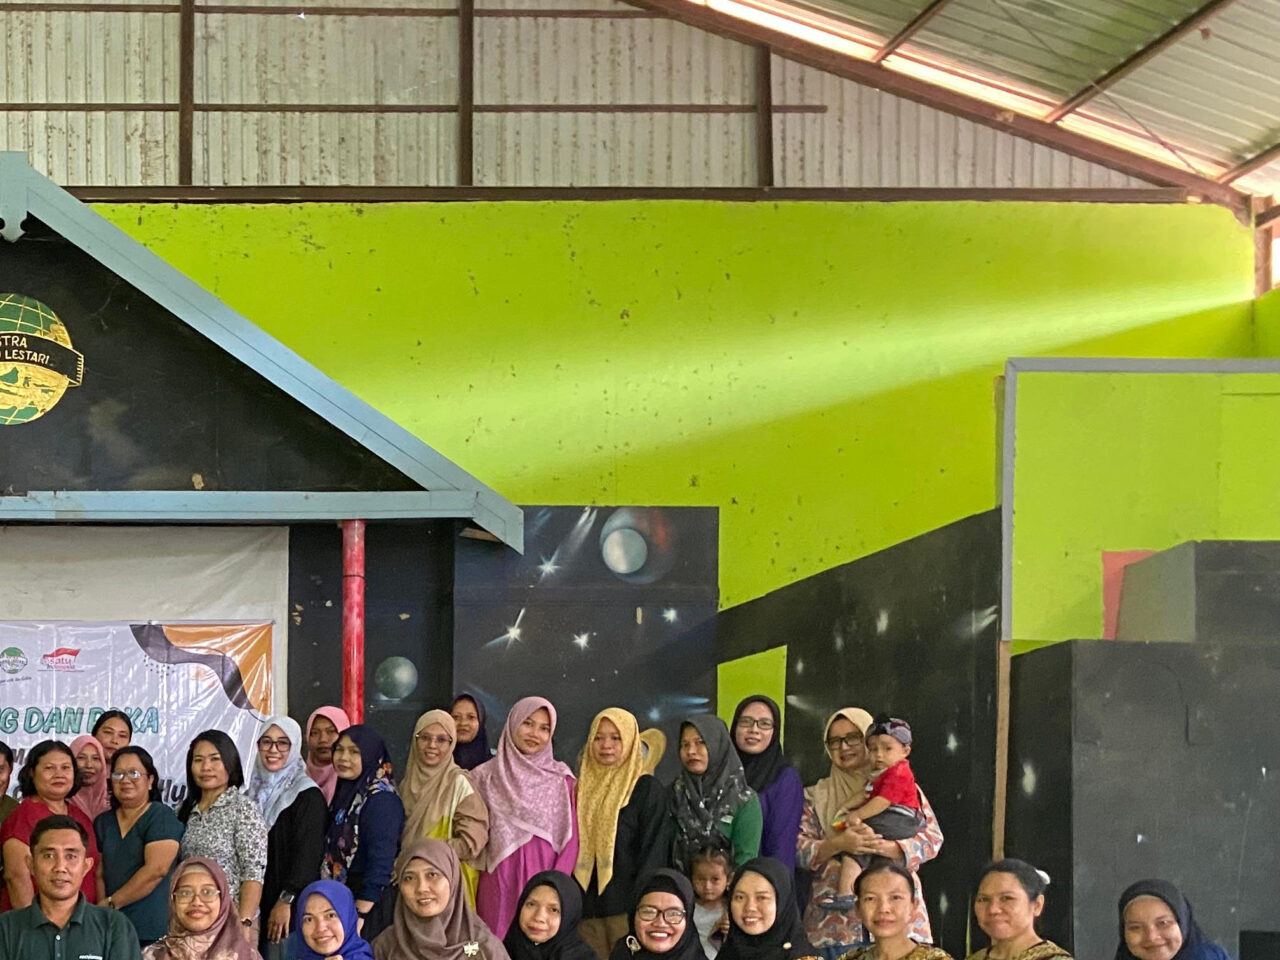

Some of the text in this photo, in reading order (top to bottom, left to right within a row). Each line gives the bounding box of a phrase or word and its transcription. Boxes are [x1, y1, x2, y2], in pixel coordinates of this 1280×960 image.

[4, 349, 50, 365] LESTARI
[23, 706, 85, 735] DAN
[86, 706, 159, 735] PKA
